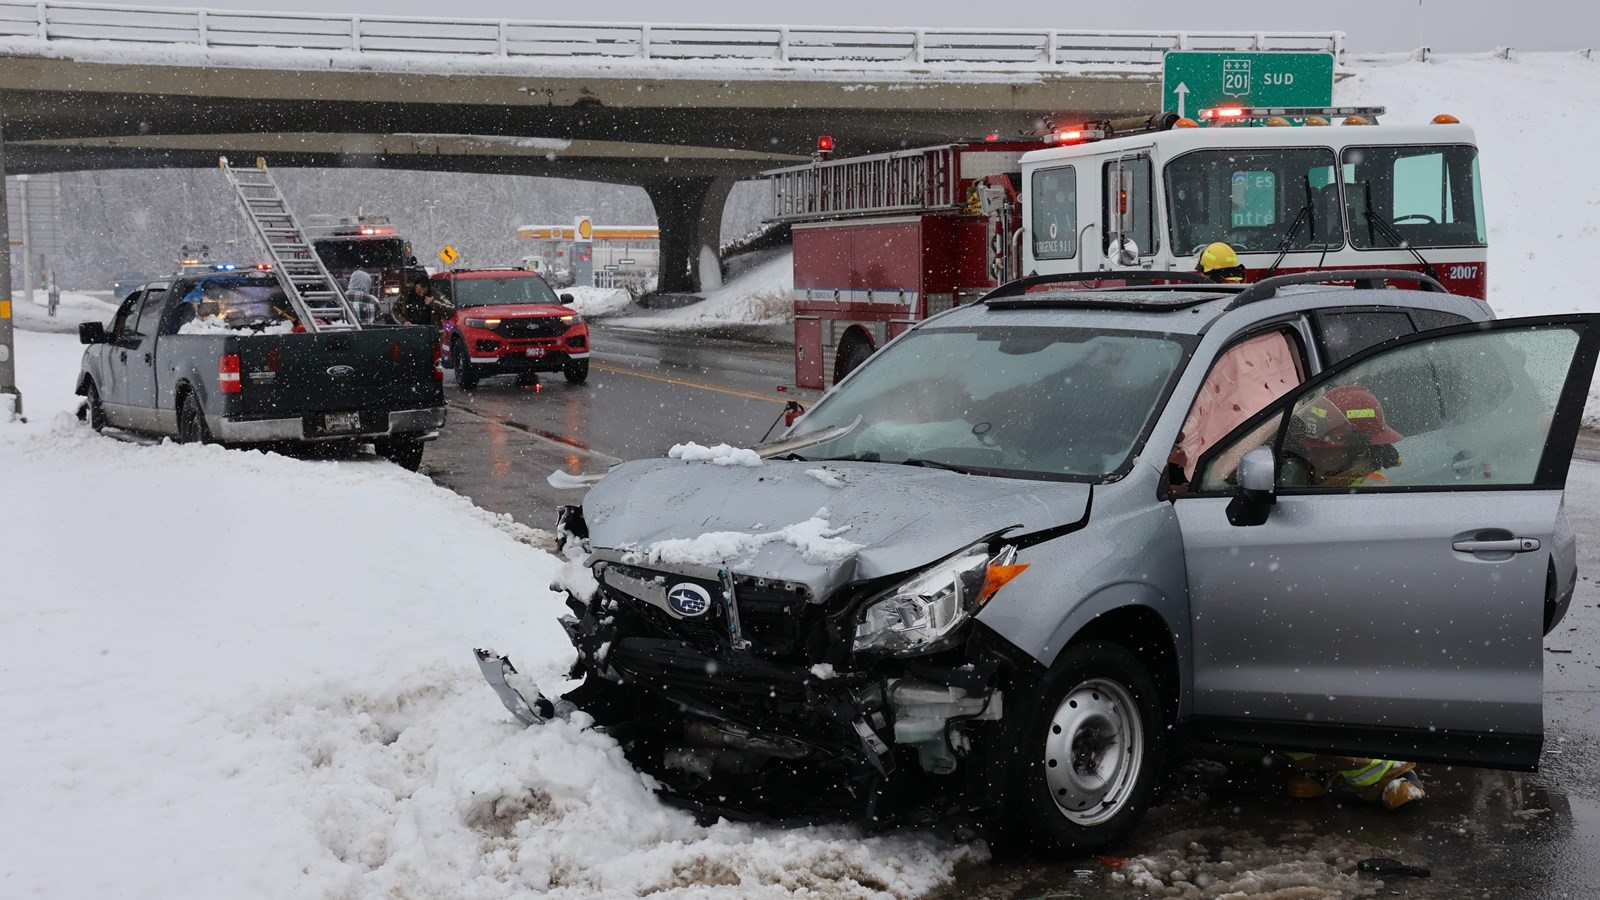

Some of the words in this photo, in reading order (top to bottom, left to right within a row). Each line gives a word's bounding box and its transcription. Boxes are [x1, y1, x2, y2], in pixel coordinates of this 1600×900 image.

[1225, 74, 1247, 89] 201
[1263, 72, 1294, 85] SUD
[1059, 240, 1072, 252] 911
[1450, 265, 1478, 279] 2007
